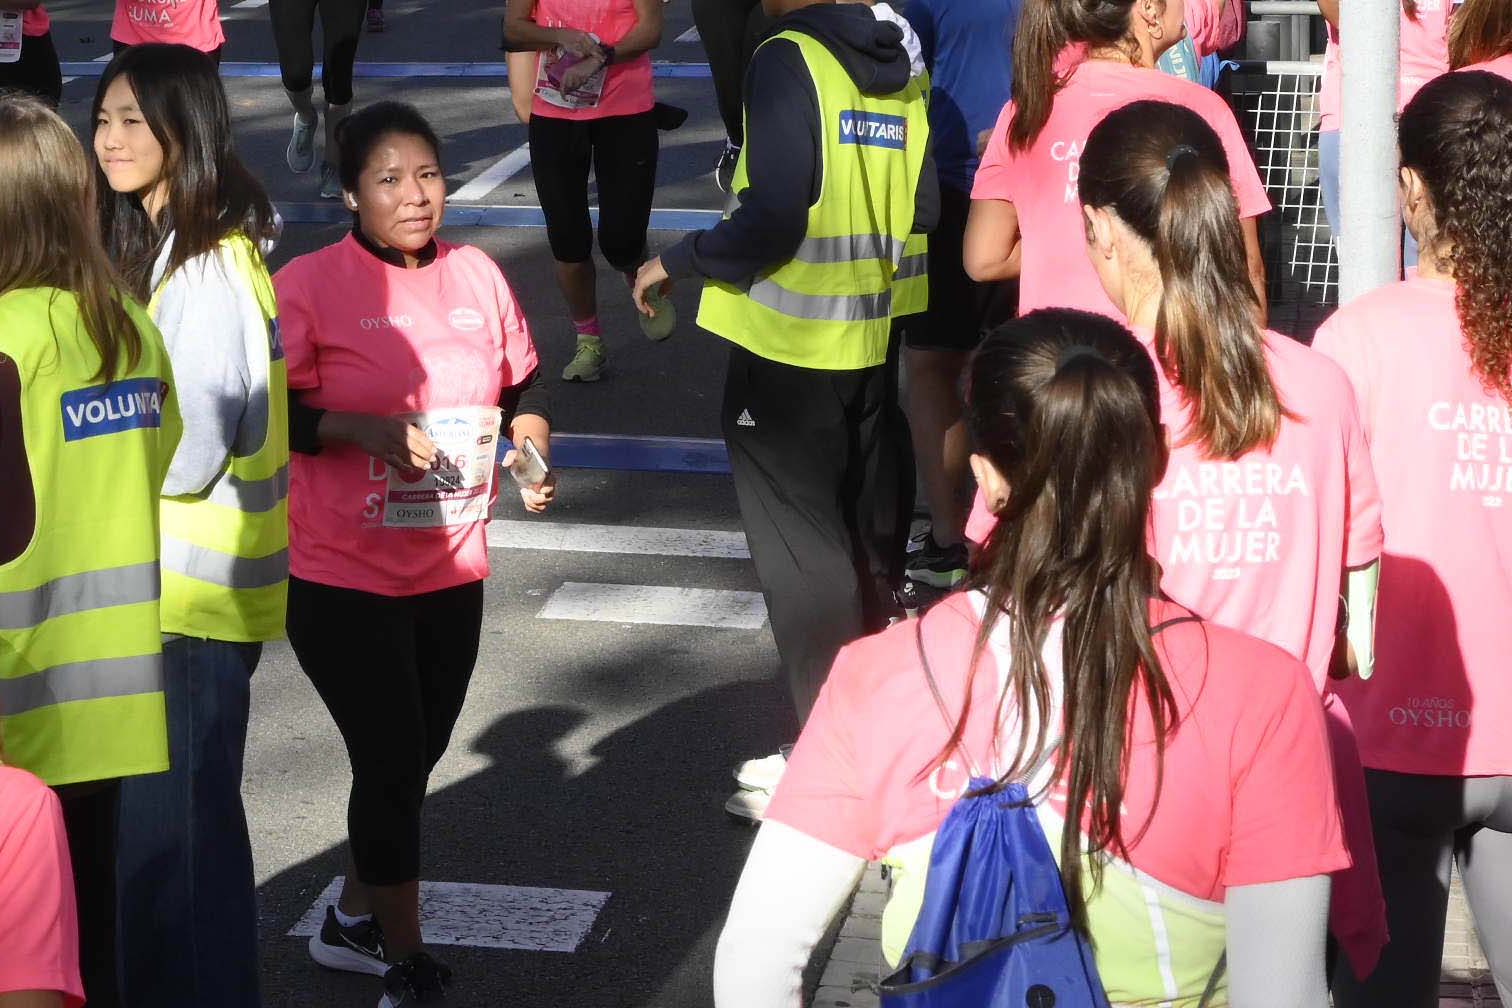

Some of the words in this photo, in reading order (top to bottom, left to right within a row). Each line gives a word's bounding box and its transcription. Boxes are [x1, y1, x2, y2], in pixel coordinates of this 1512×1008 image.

[360, 314, 413, 330] OYSHO
[737, 419, 756, 427] adidas
[1457, 434, 1487, 462] DE
[1177, 498, 1225, 531] DE
[1237, 495, 1278, 529] LA
[1169, 533, 1281, 565] MUJER
[1389, 706, 1471, 729] OYSHO
